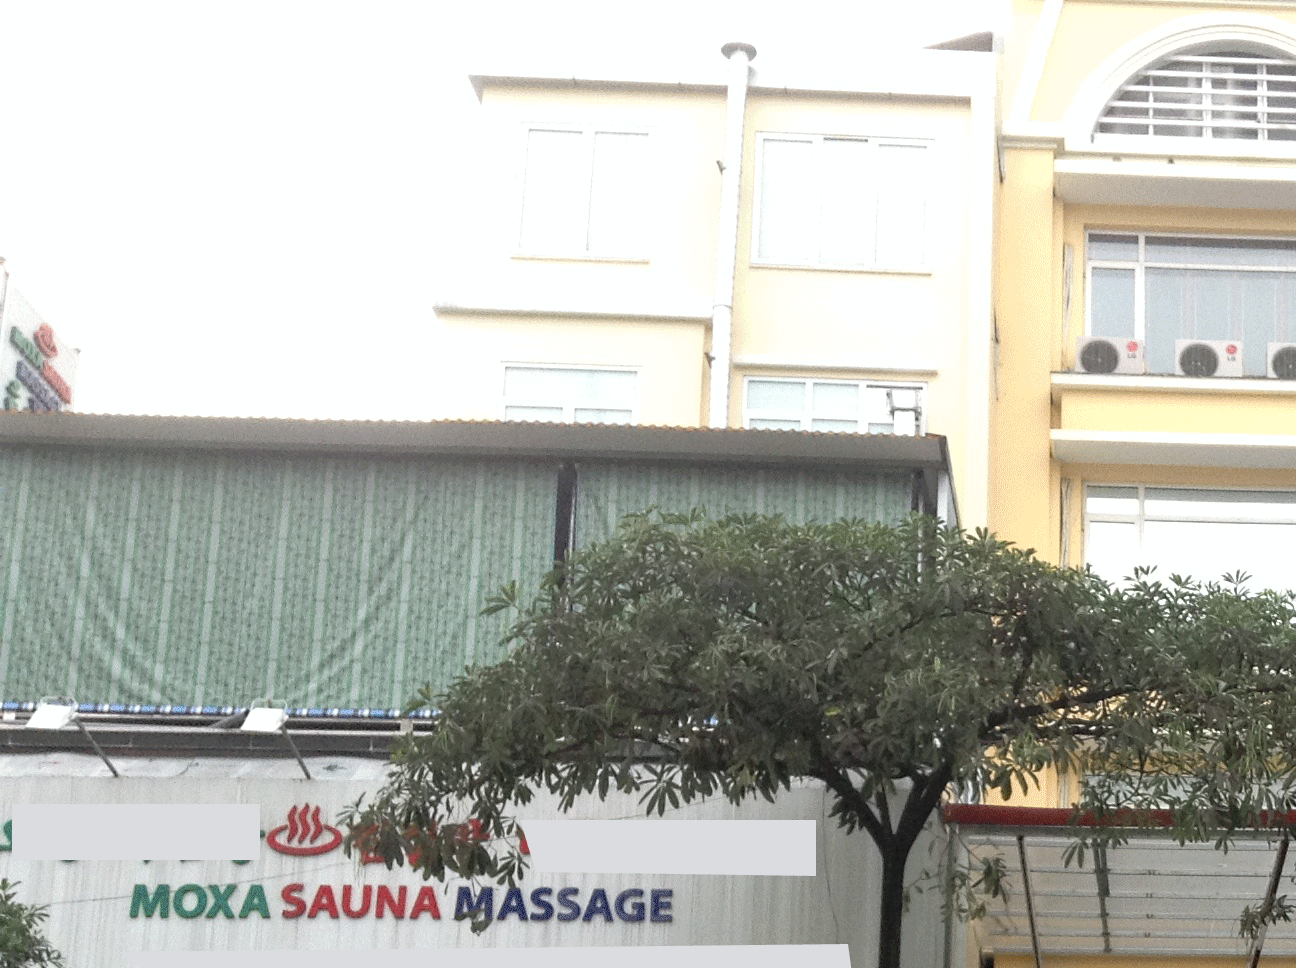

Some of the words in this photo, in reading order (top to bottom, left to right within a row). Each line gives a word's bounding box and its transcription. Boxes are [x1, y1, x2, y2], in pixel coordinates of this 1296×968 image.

[129, 883, 271, 919] MOXA
[281, 883, 441, 920] SAUNA
[454, 886, 674, 923] MASSAGE
